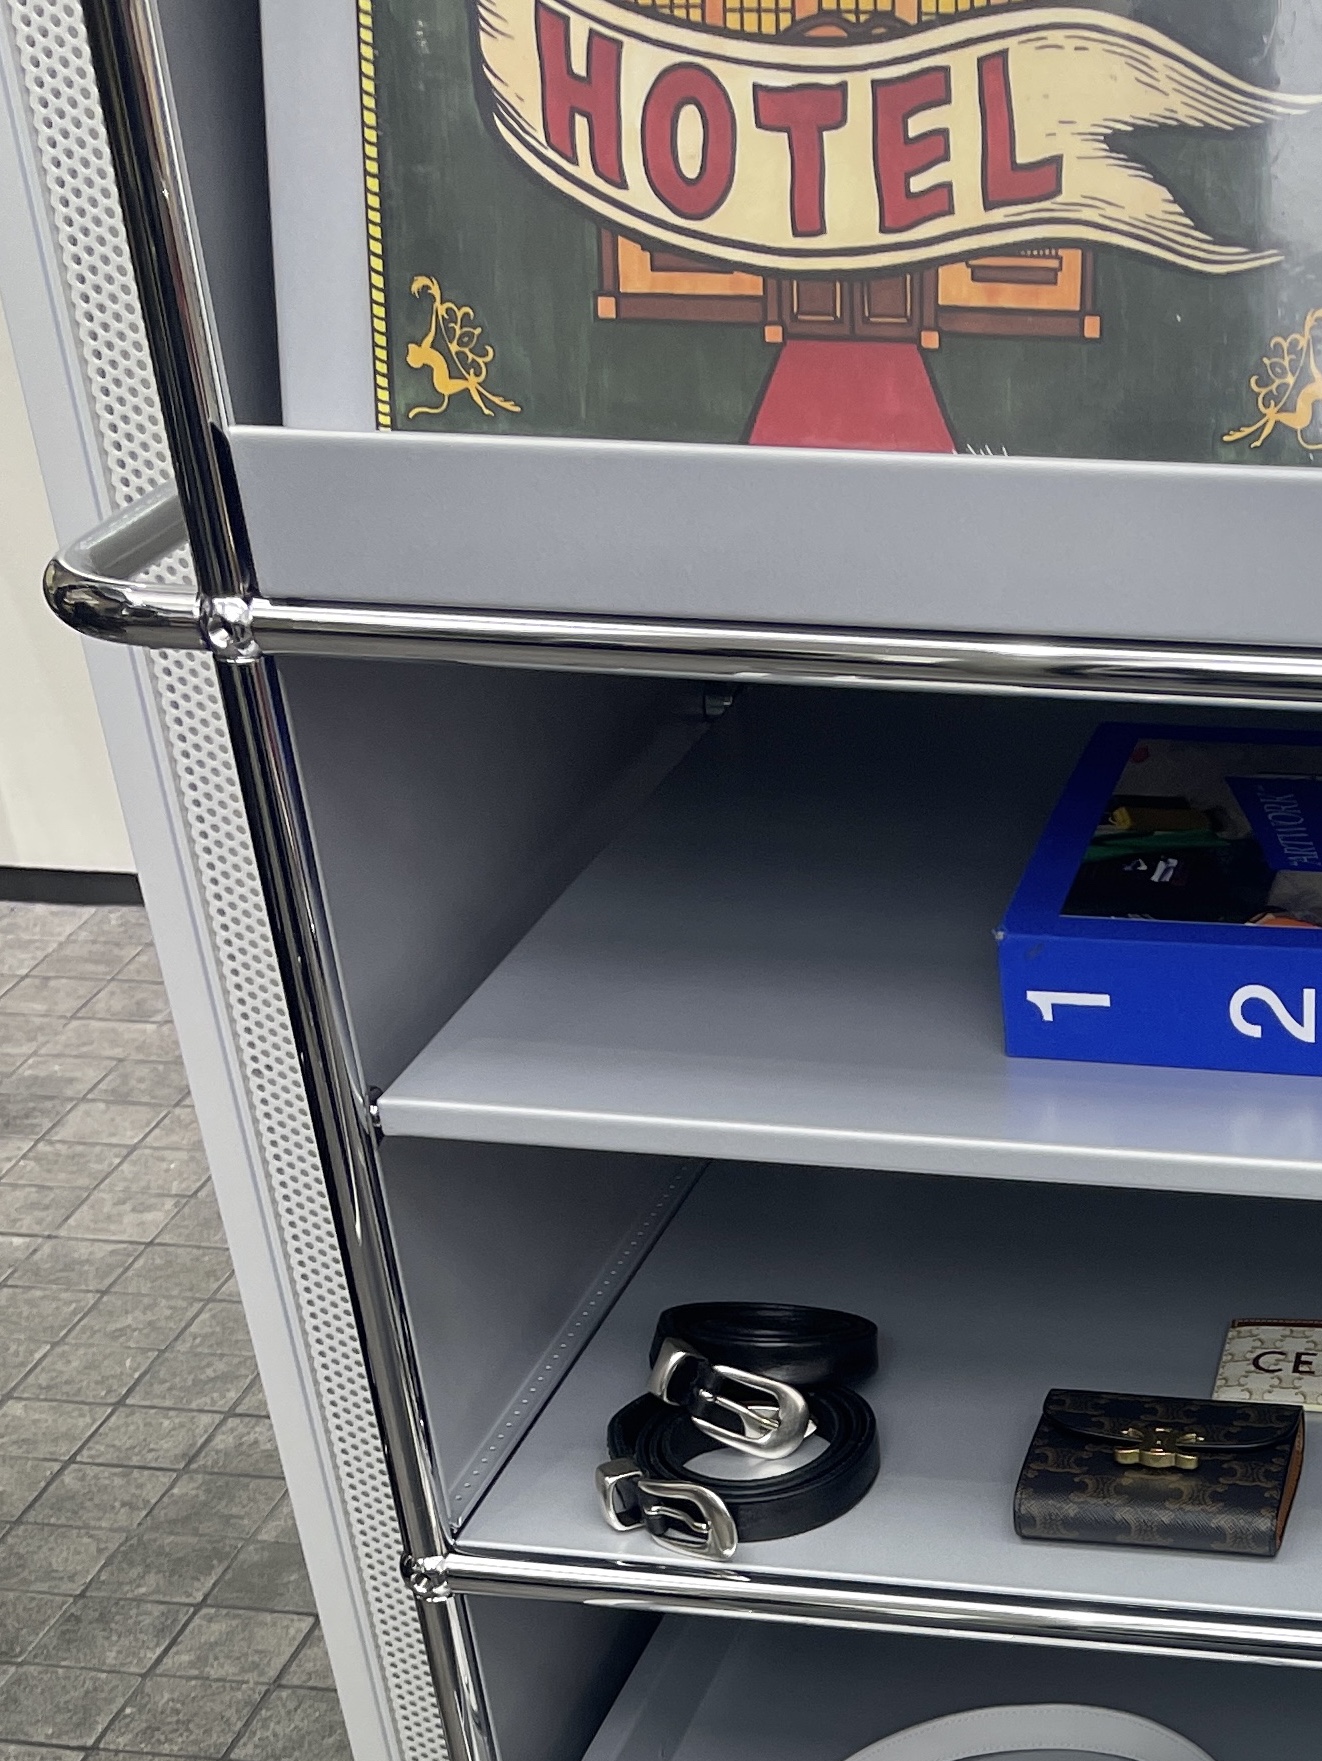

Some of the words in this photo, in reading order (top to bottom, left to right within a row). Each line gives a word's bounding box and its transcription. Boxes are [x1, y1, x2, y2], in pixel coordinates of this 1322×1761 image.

[535, 0, 1063, 237] HOTEL
[1026, 989, 1111, 1022] 1
[1230, 984, 1316, 1043] 2
